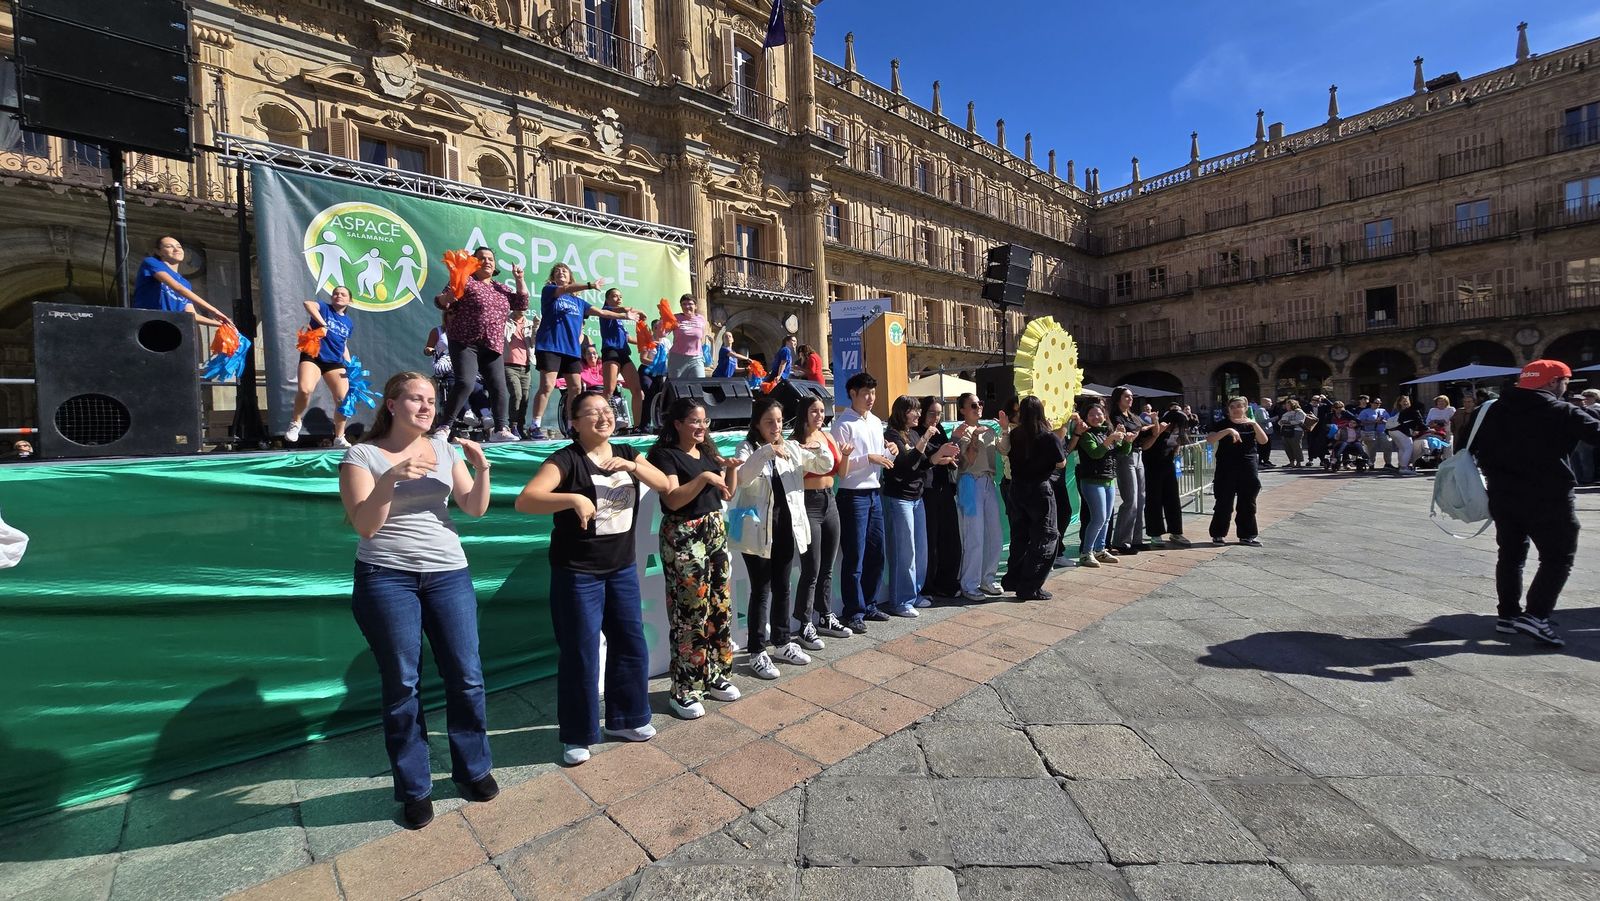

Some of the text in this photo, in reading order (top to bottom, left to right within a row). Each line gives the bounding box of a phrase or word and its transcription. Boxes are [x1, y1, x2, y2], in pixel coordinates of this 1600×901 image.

[330, 215, 401, 237] ASPACE
[346, 231, 395, 243] SALAMANCA
[464, 226, 639, 287] ASPACE
